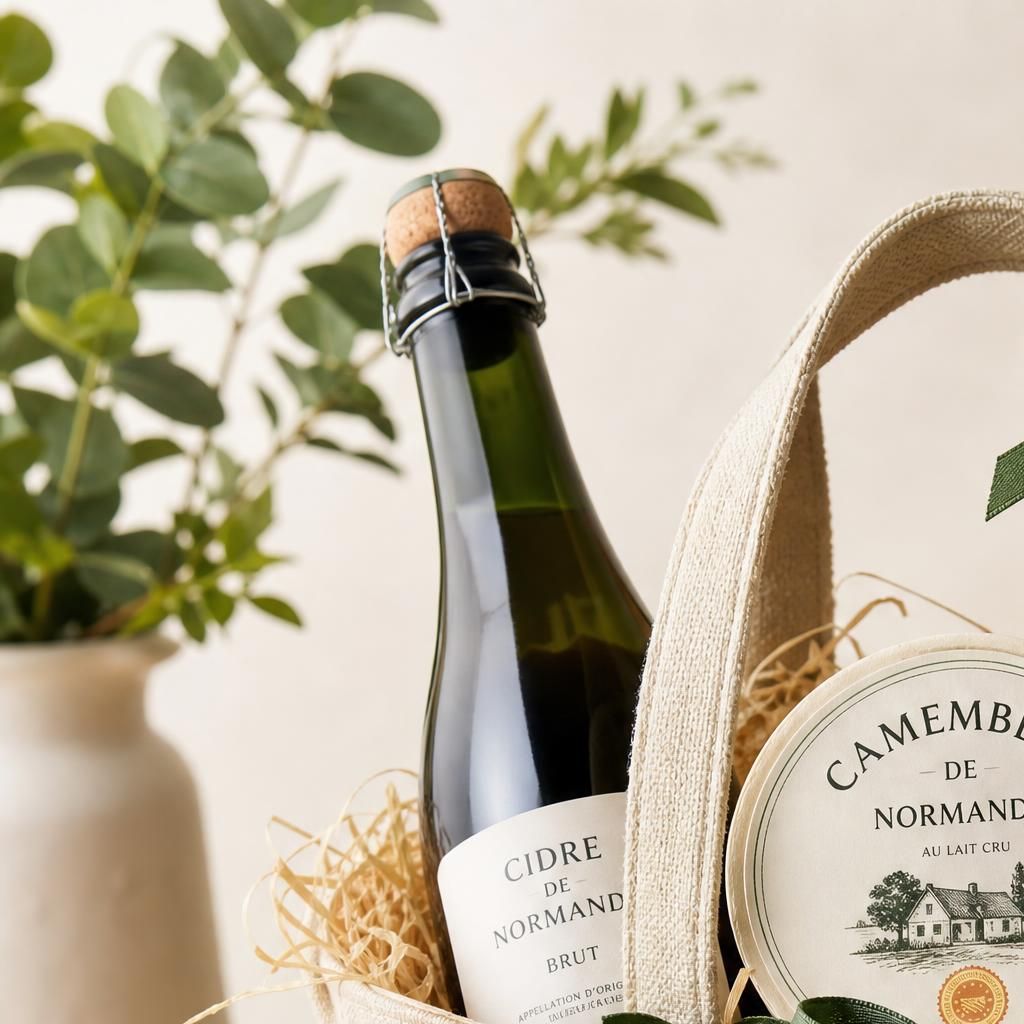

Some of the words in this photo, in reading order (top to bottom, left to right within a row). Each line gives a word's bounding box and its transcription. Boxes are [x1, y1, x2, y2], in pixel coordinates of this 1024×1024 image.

[944, 760, 977, 780] DE
[504, 835, 602, 882] CIDRE
[922, 846, 941, 858] AU
[947, 843, 977, 856] LAIT
[982, 841, 1011, 853] CRU
[544, 877, 571, 897] DE
[546, 945, 599, 974] BRUT
[518, 991, 581, 1023] APPELLATION
